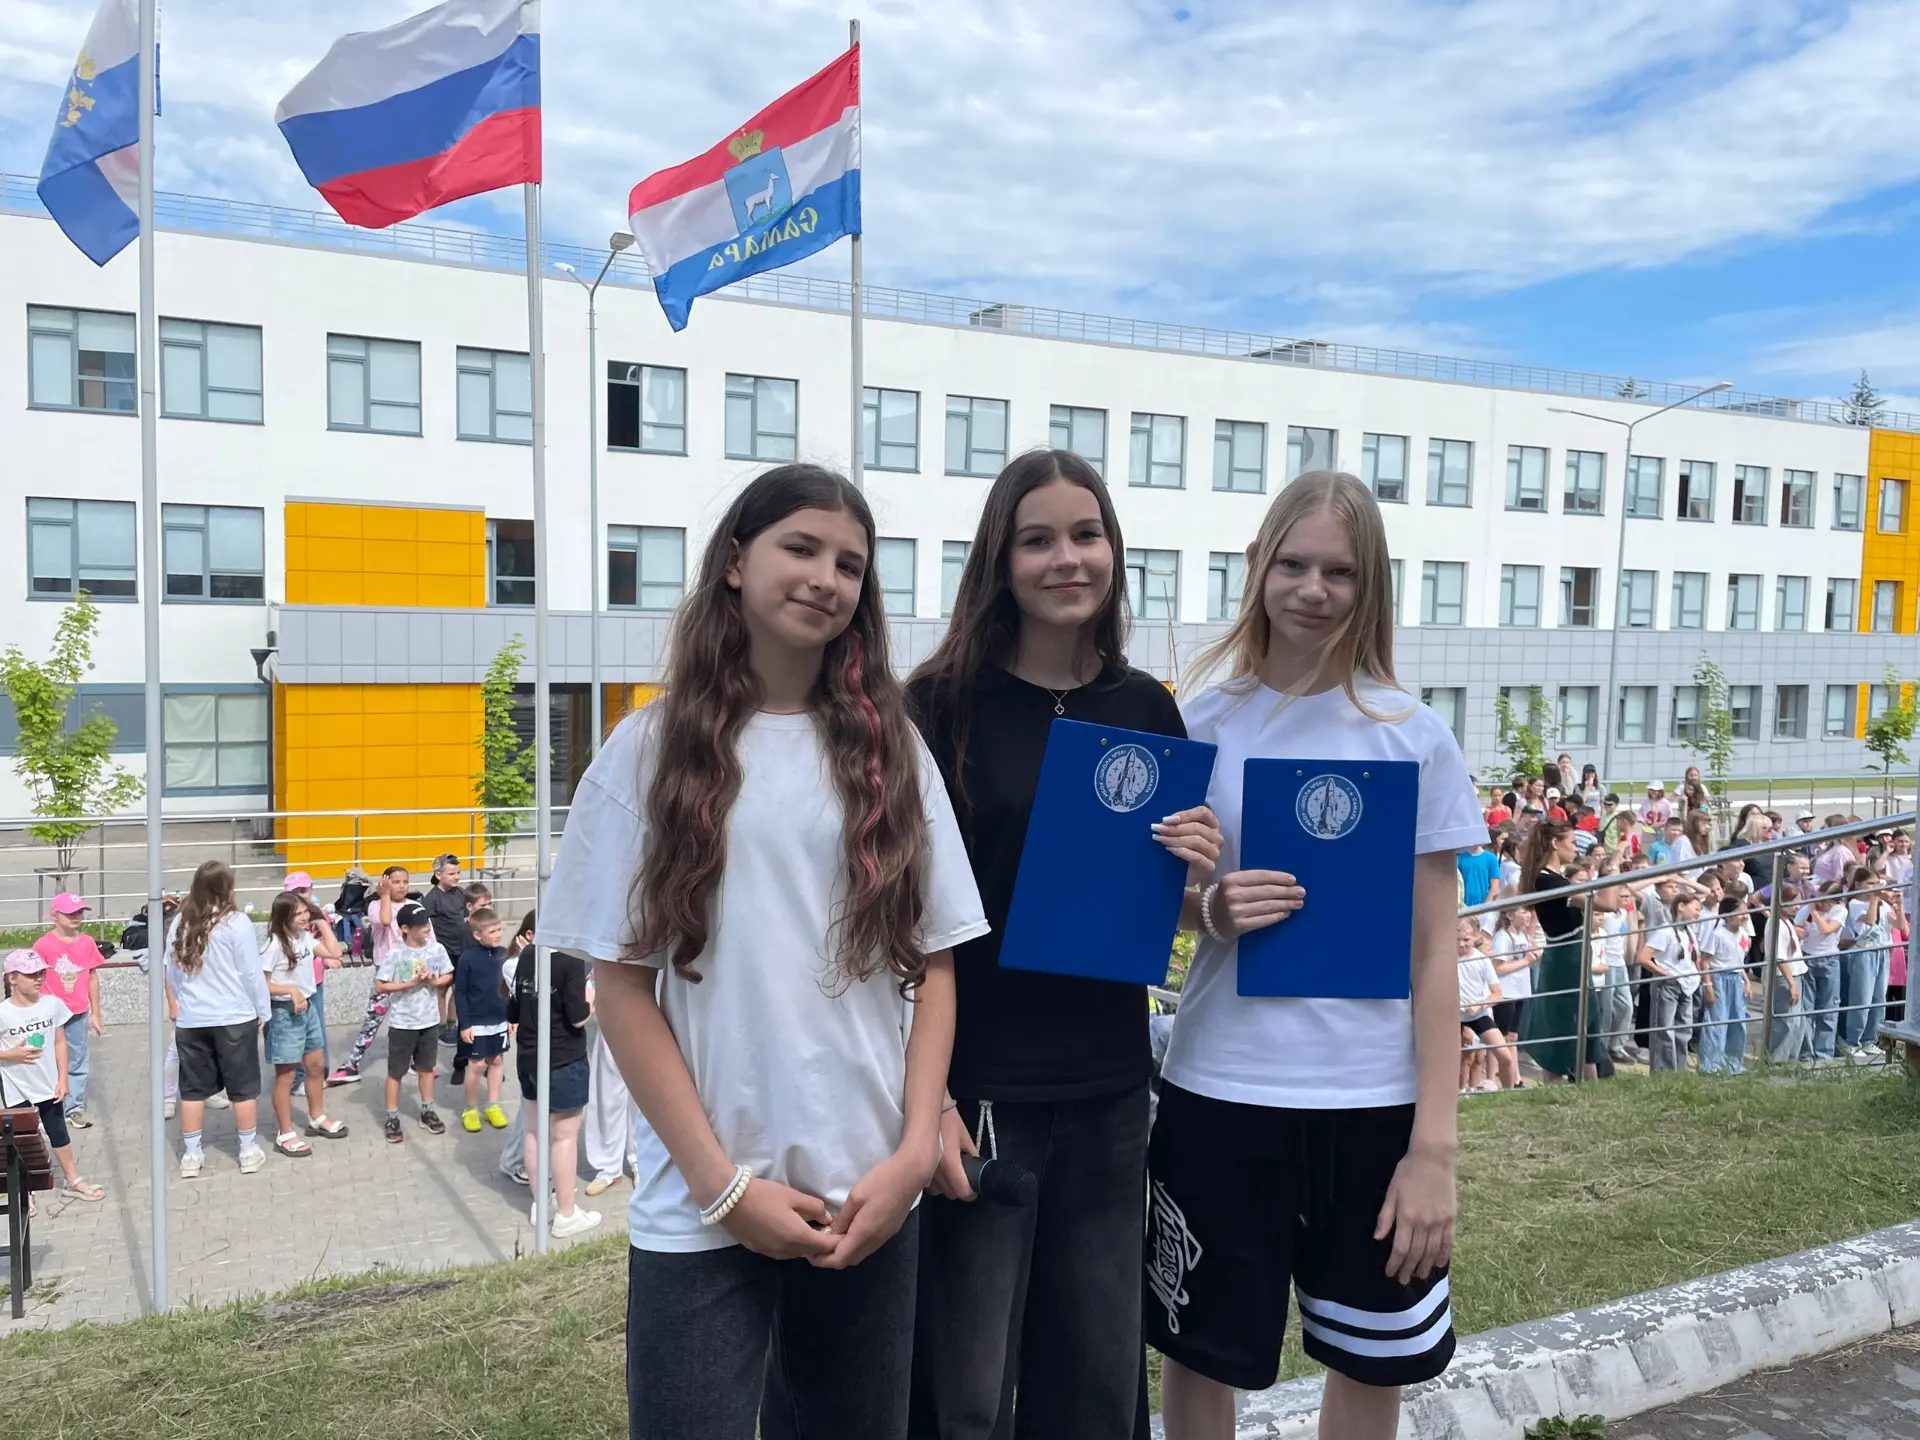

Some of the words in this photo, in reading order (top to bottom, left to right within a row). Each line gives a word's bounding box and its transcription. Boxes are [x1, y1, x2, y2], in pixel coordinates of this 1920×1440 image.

[1145, 770, 1155, 794] САМАРА
[9, 1018, 53, 1036] CACTUS
[499, 1032, 508, 1049] 7
